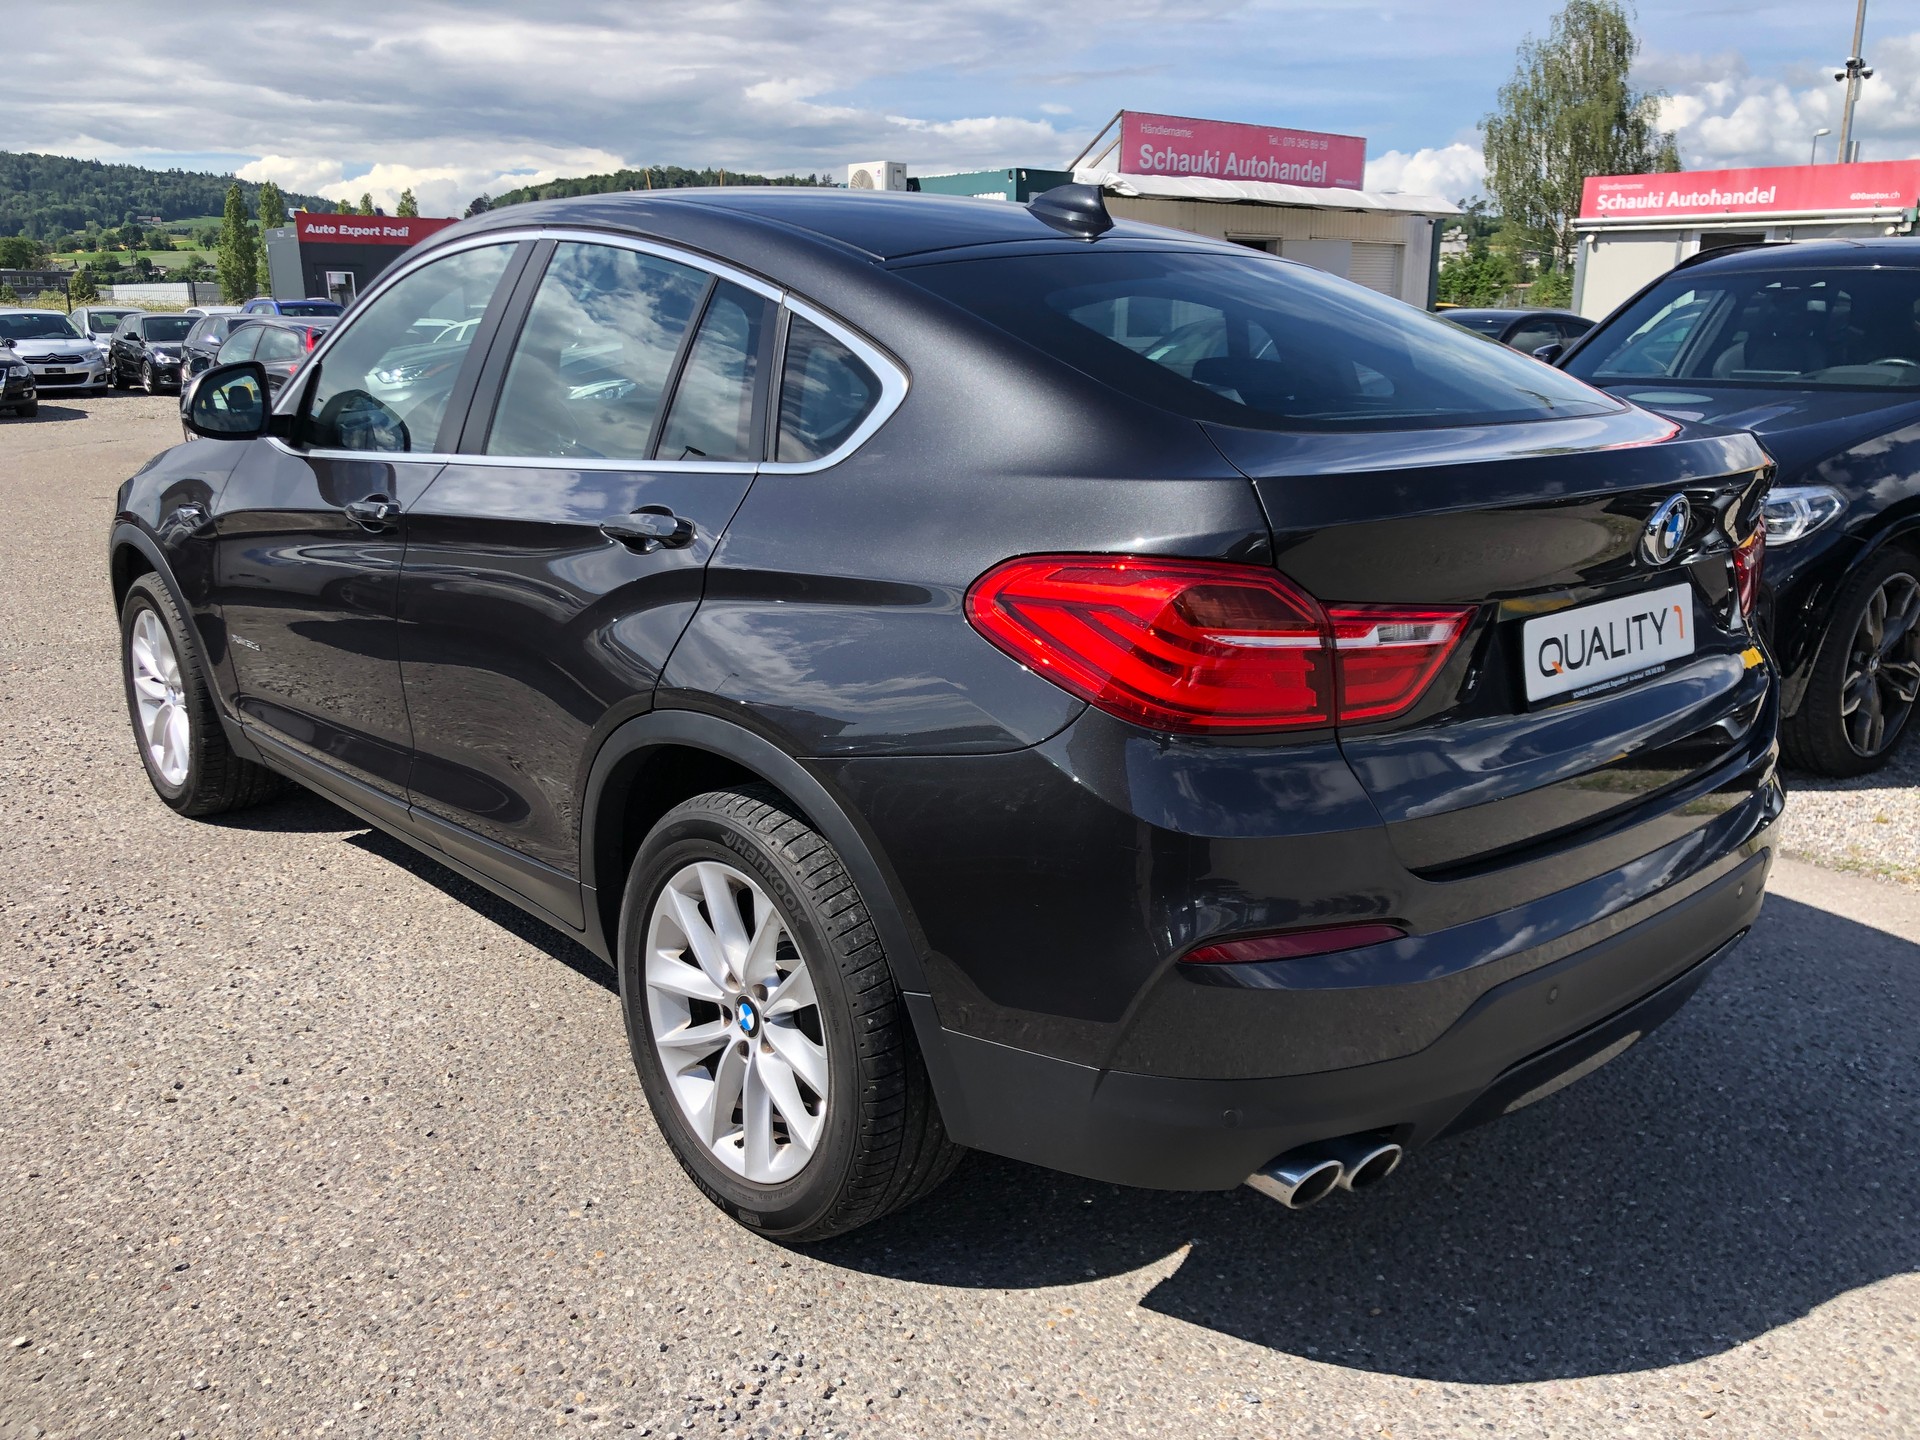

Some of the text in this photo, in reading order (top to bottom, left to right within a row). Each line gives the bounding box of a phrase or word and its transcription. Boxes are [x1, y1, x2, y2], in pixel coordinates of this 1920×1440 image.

[1139, 143, 1327, 183] Schauki Autohandel
[1596, 186, 1776, 210] Schauki Autohandel
[305, 223, 409, 237] Auto Export Fadi
